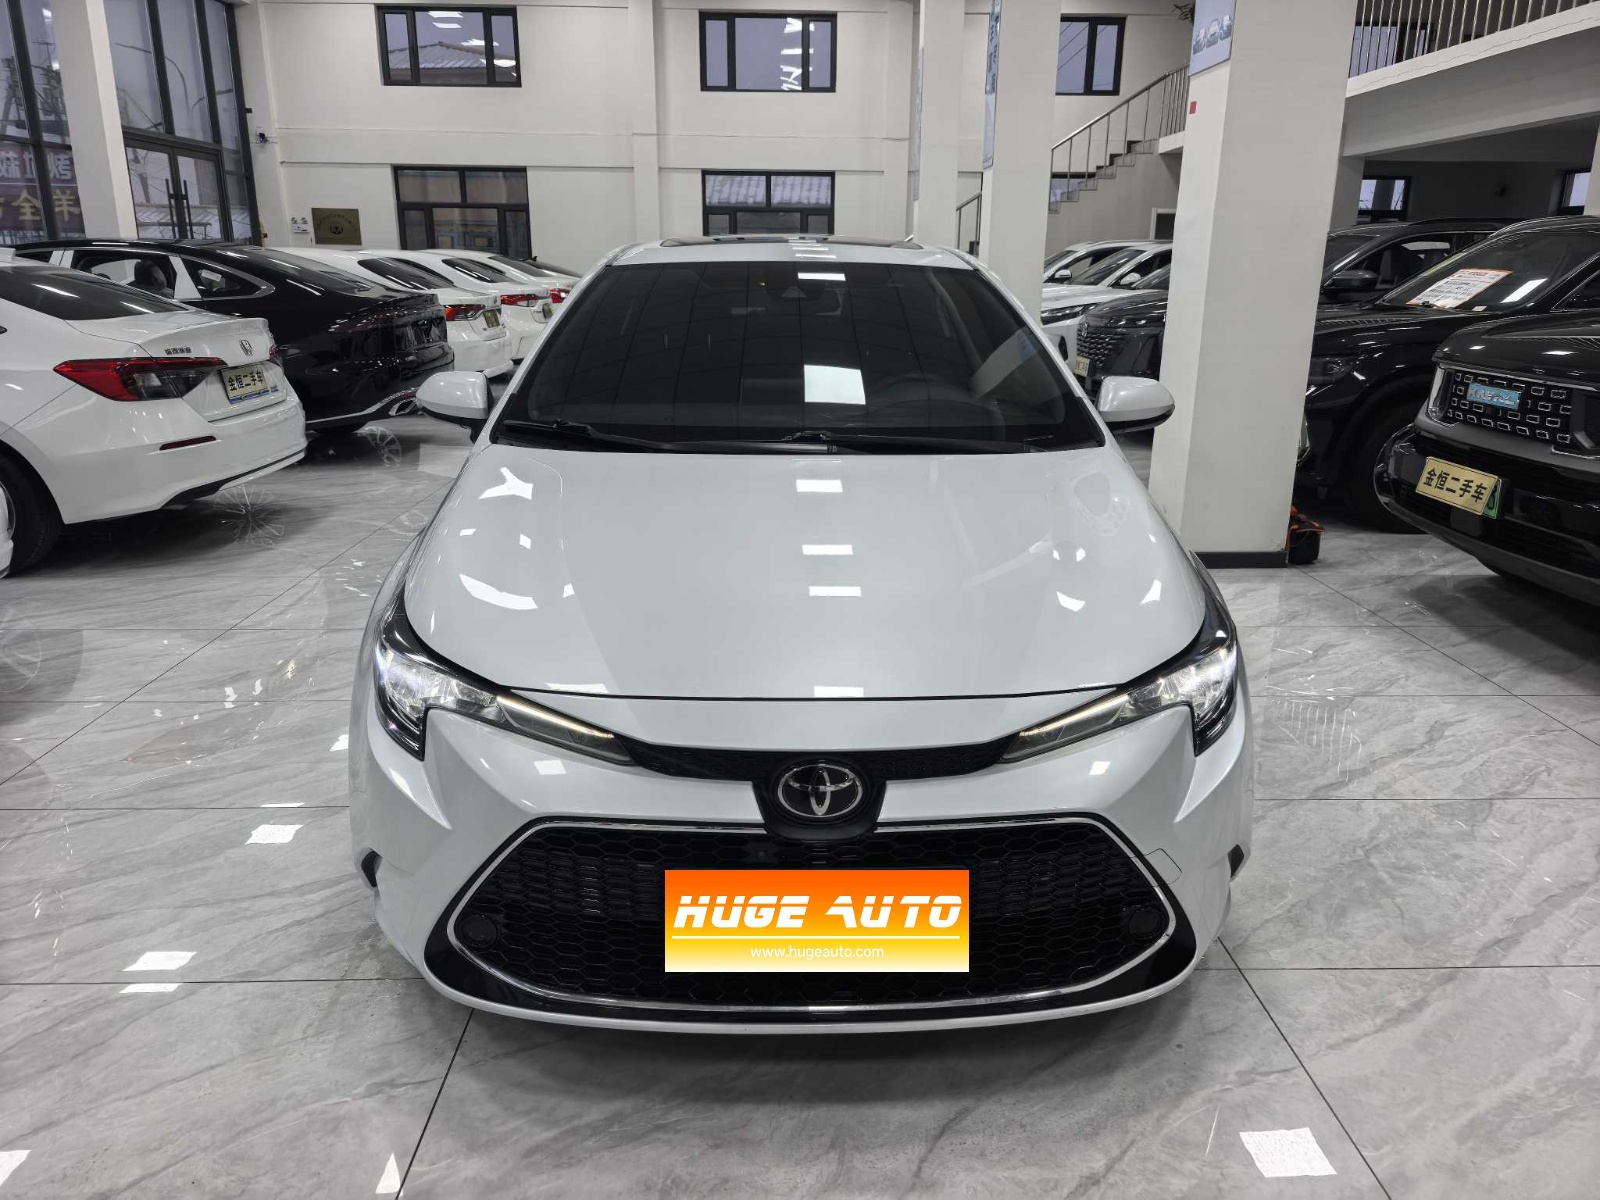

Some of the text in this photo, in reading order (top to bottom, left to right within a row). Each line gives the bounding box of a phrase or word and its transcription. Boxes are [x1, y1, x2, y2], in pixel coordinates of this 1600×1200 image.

[0, 188, 81, 222] 全羊
[1423, 468, 1487, 503] 金恒二手车
